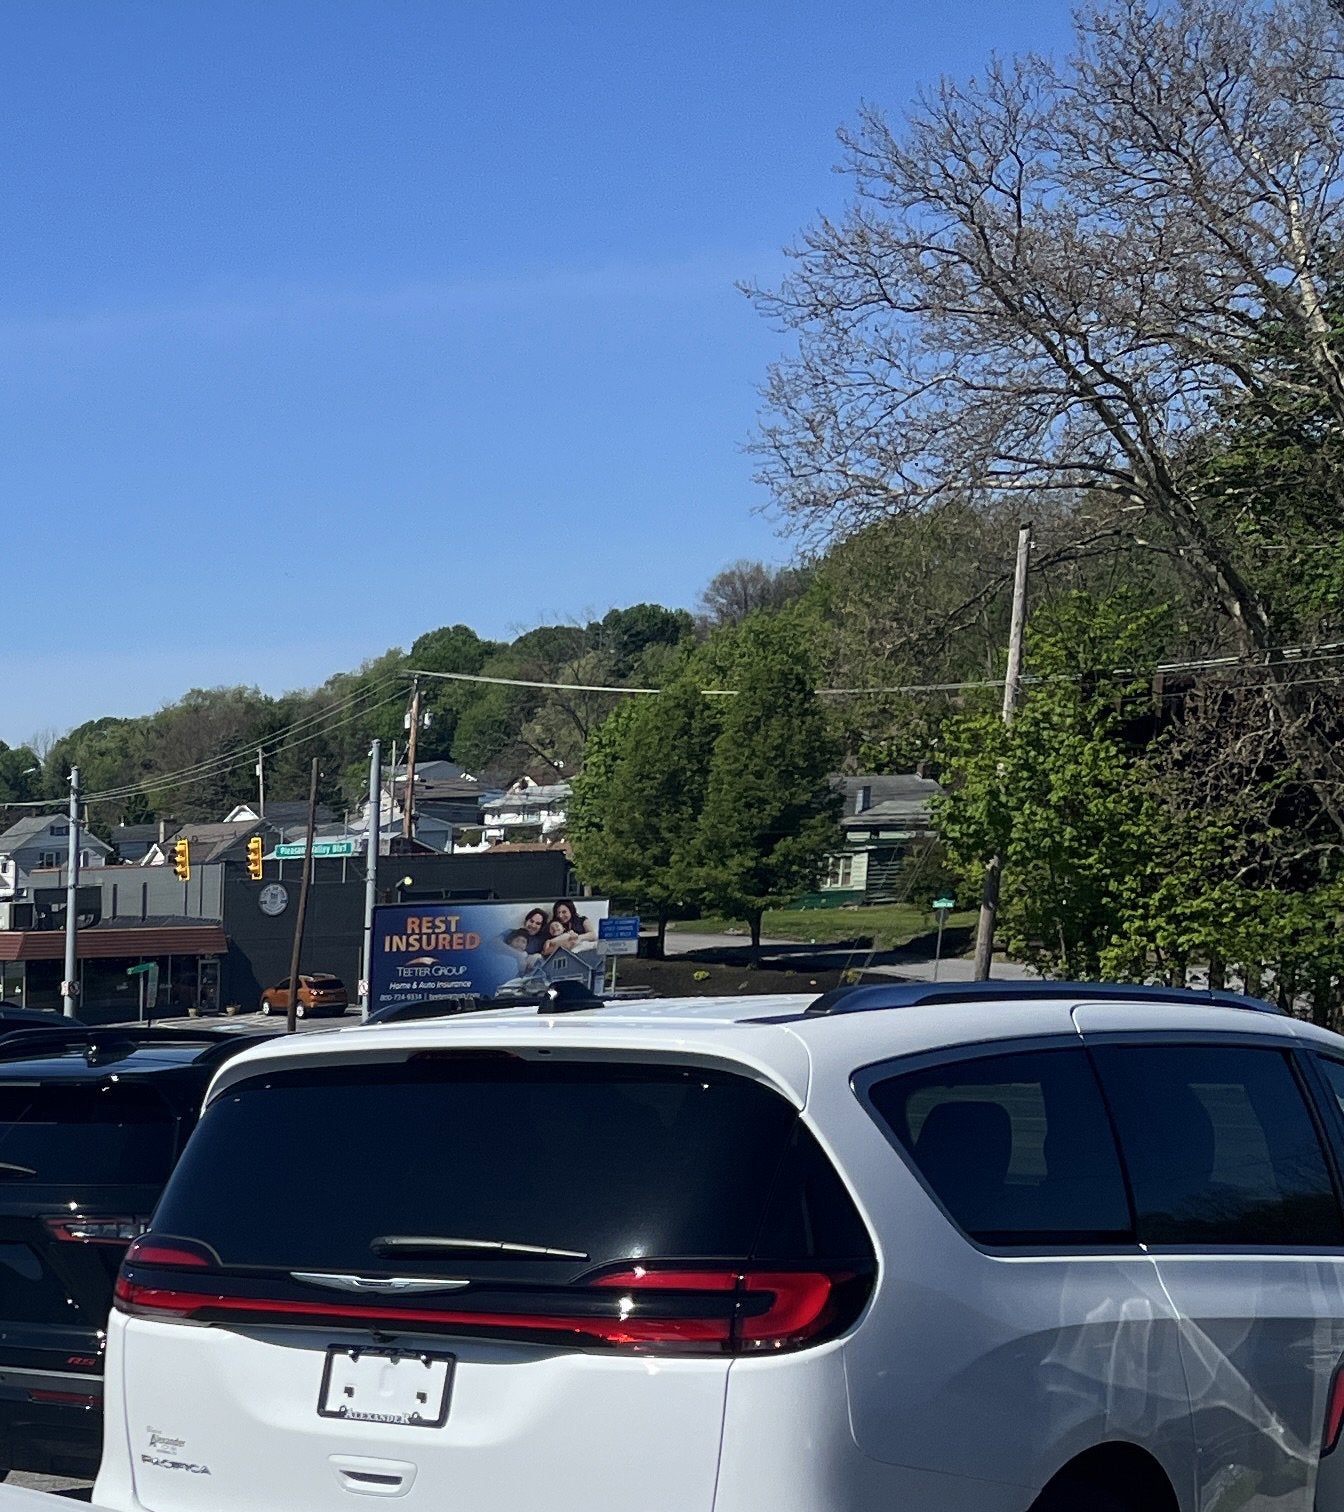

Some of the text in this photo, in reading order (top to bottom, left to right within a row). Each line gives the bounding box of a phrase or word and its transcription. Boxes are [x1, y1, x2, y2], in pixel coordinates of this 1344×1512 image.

[407, 916, 460, 934] REST
[384, 932, 480, 952] INSURED
[396, 965, 467, 977] TEETER GROUP
[389, 982, 411, 990] Home
[418, 981, 436, 989] Auto
[436, 981, 472, 989] Insurance
[67, 1356, 97, 1366] RS
[344, 1408, 411, 1424] ALEXANDER
[141, 1454, 212, 1476] PACIFICA
